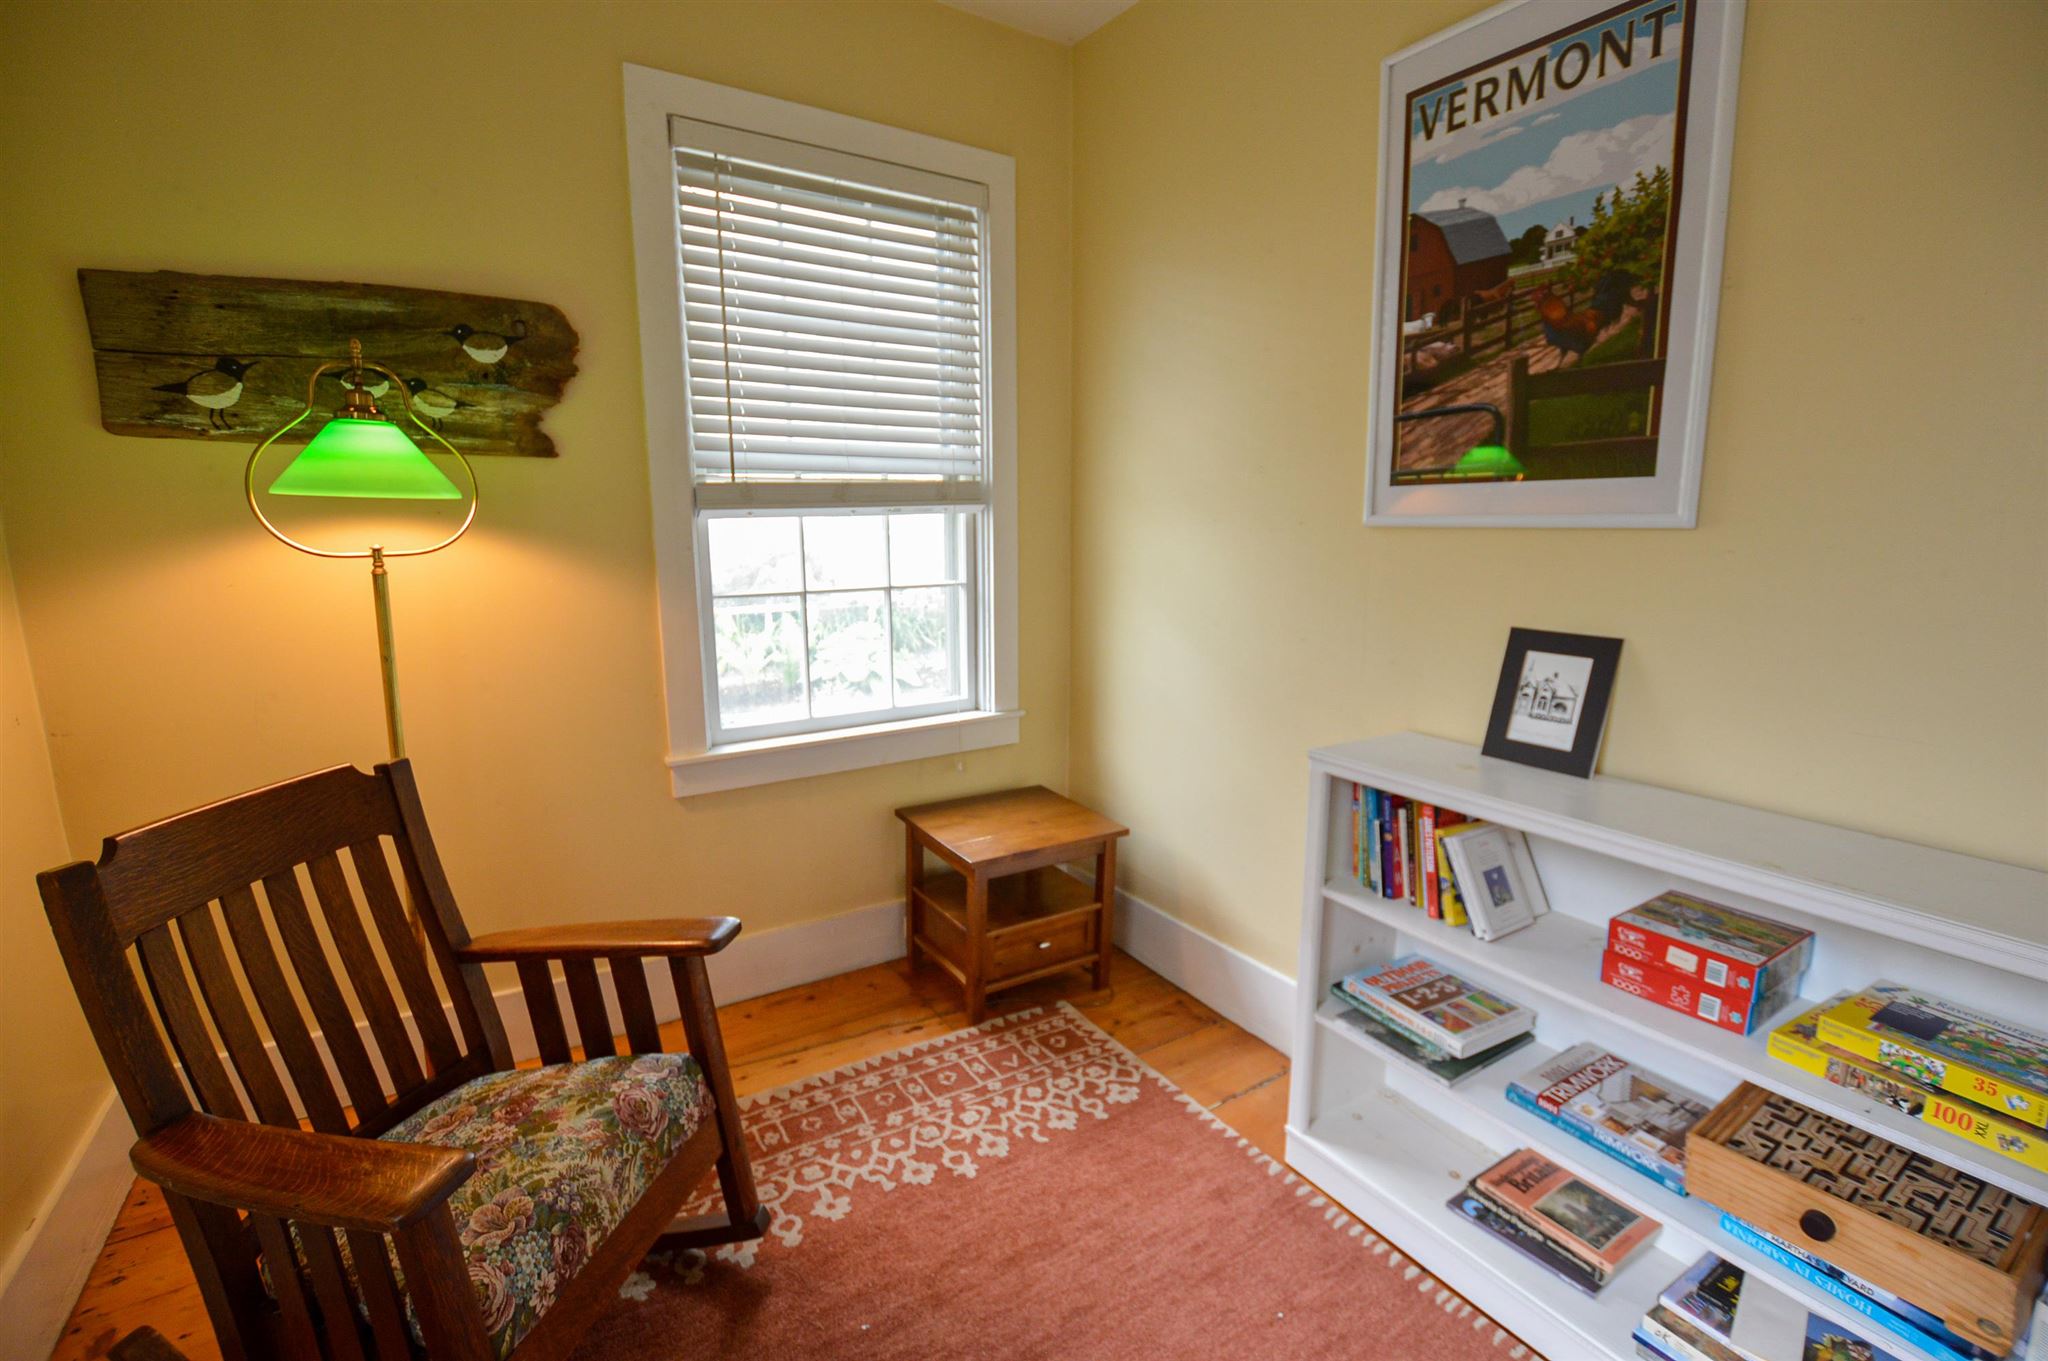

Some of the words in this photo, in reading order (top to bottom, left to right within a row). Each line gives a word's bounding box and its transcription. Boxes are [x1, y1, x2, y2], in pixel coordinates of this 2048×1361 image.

[1418, 3, 1677, 142] VERMONT
[1614, 942, 1642, 960] 1000
[1612, 977, 1641, 994] 1000
[1543, 1054, 1622, 1102] TRIMWORK
[1972, 1076, 1998, 1096] 35
[1932, 1100, 1973, 1131] 100
[1793, 1262, 1811, 1279] IN
[1814, 1274, 1874, 1315] HOMES
